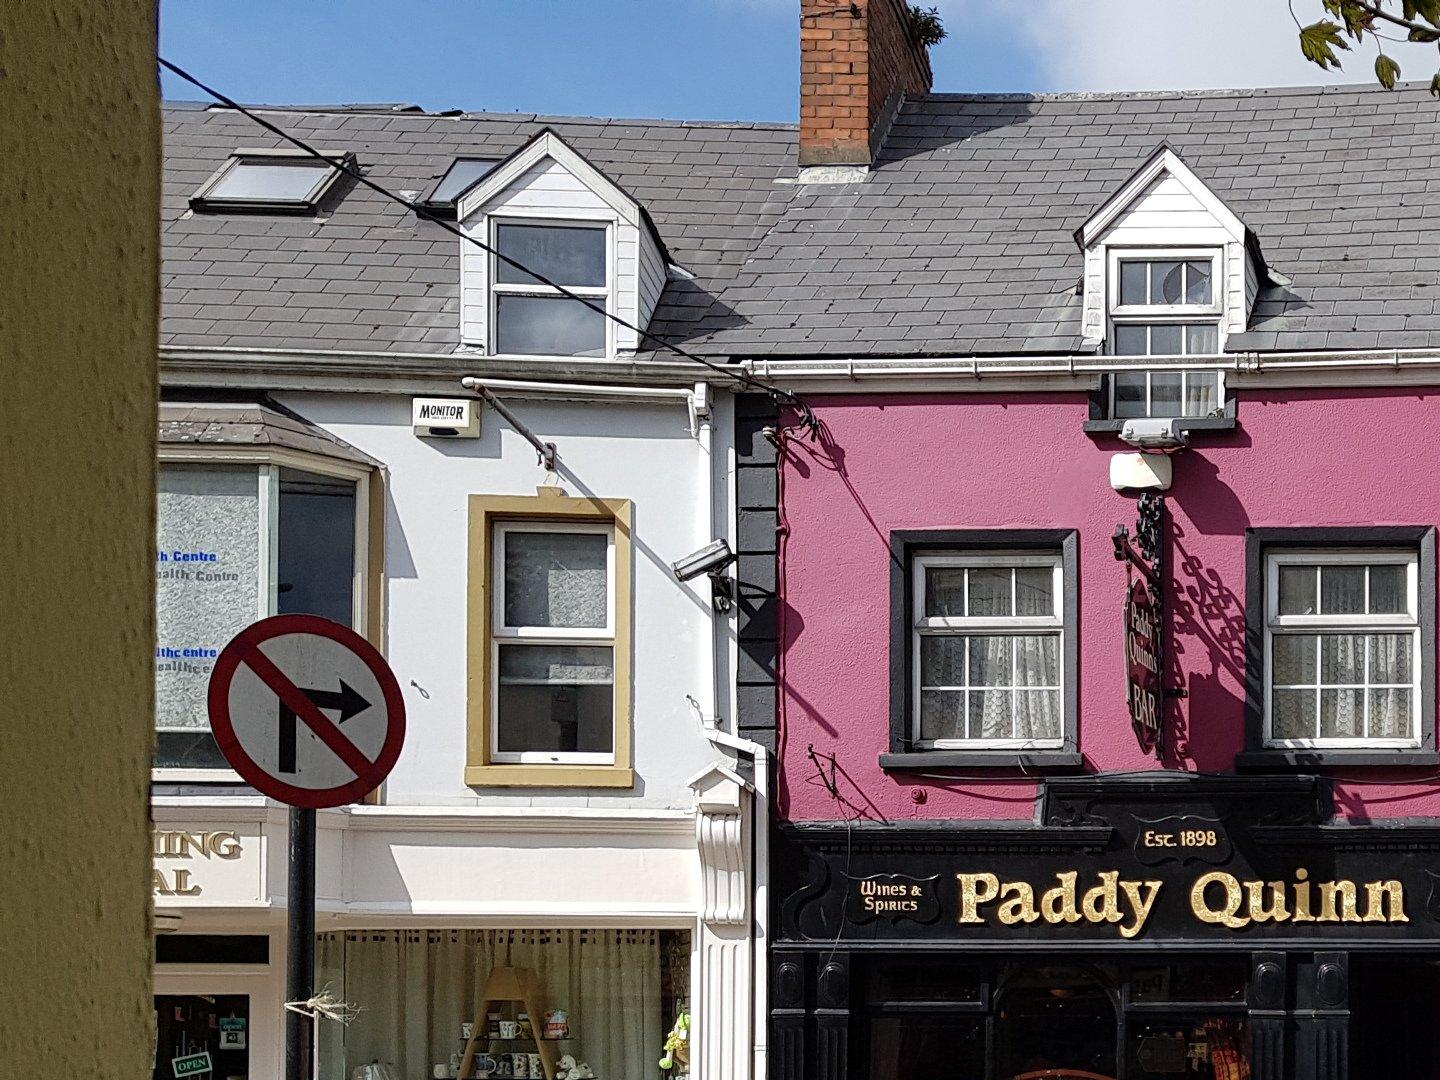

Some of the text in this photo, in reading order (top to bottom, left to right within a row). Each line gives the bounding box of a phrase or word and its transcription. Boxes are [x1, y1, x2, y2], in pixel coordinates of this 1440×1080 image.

[419, 405, 464, 420] MONITOR
[173, 551, 217, 561] Centre
[1131, 601, 1153, 649] Paddy
[1133, 684, 1157, 730] BAR
[1180, 830, 1217, 847] 1898
[860, 880, 922, 896] Wines &
[956, 867, 1410, 938] Paddy Quinn
[178, 1057, 207, 1072] OPEN
